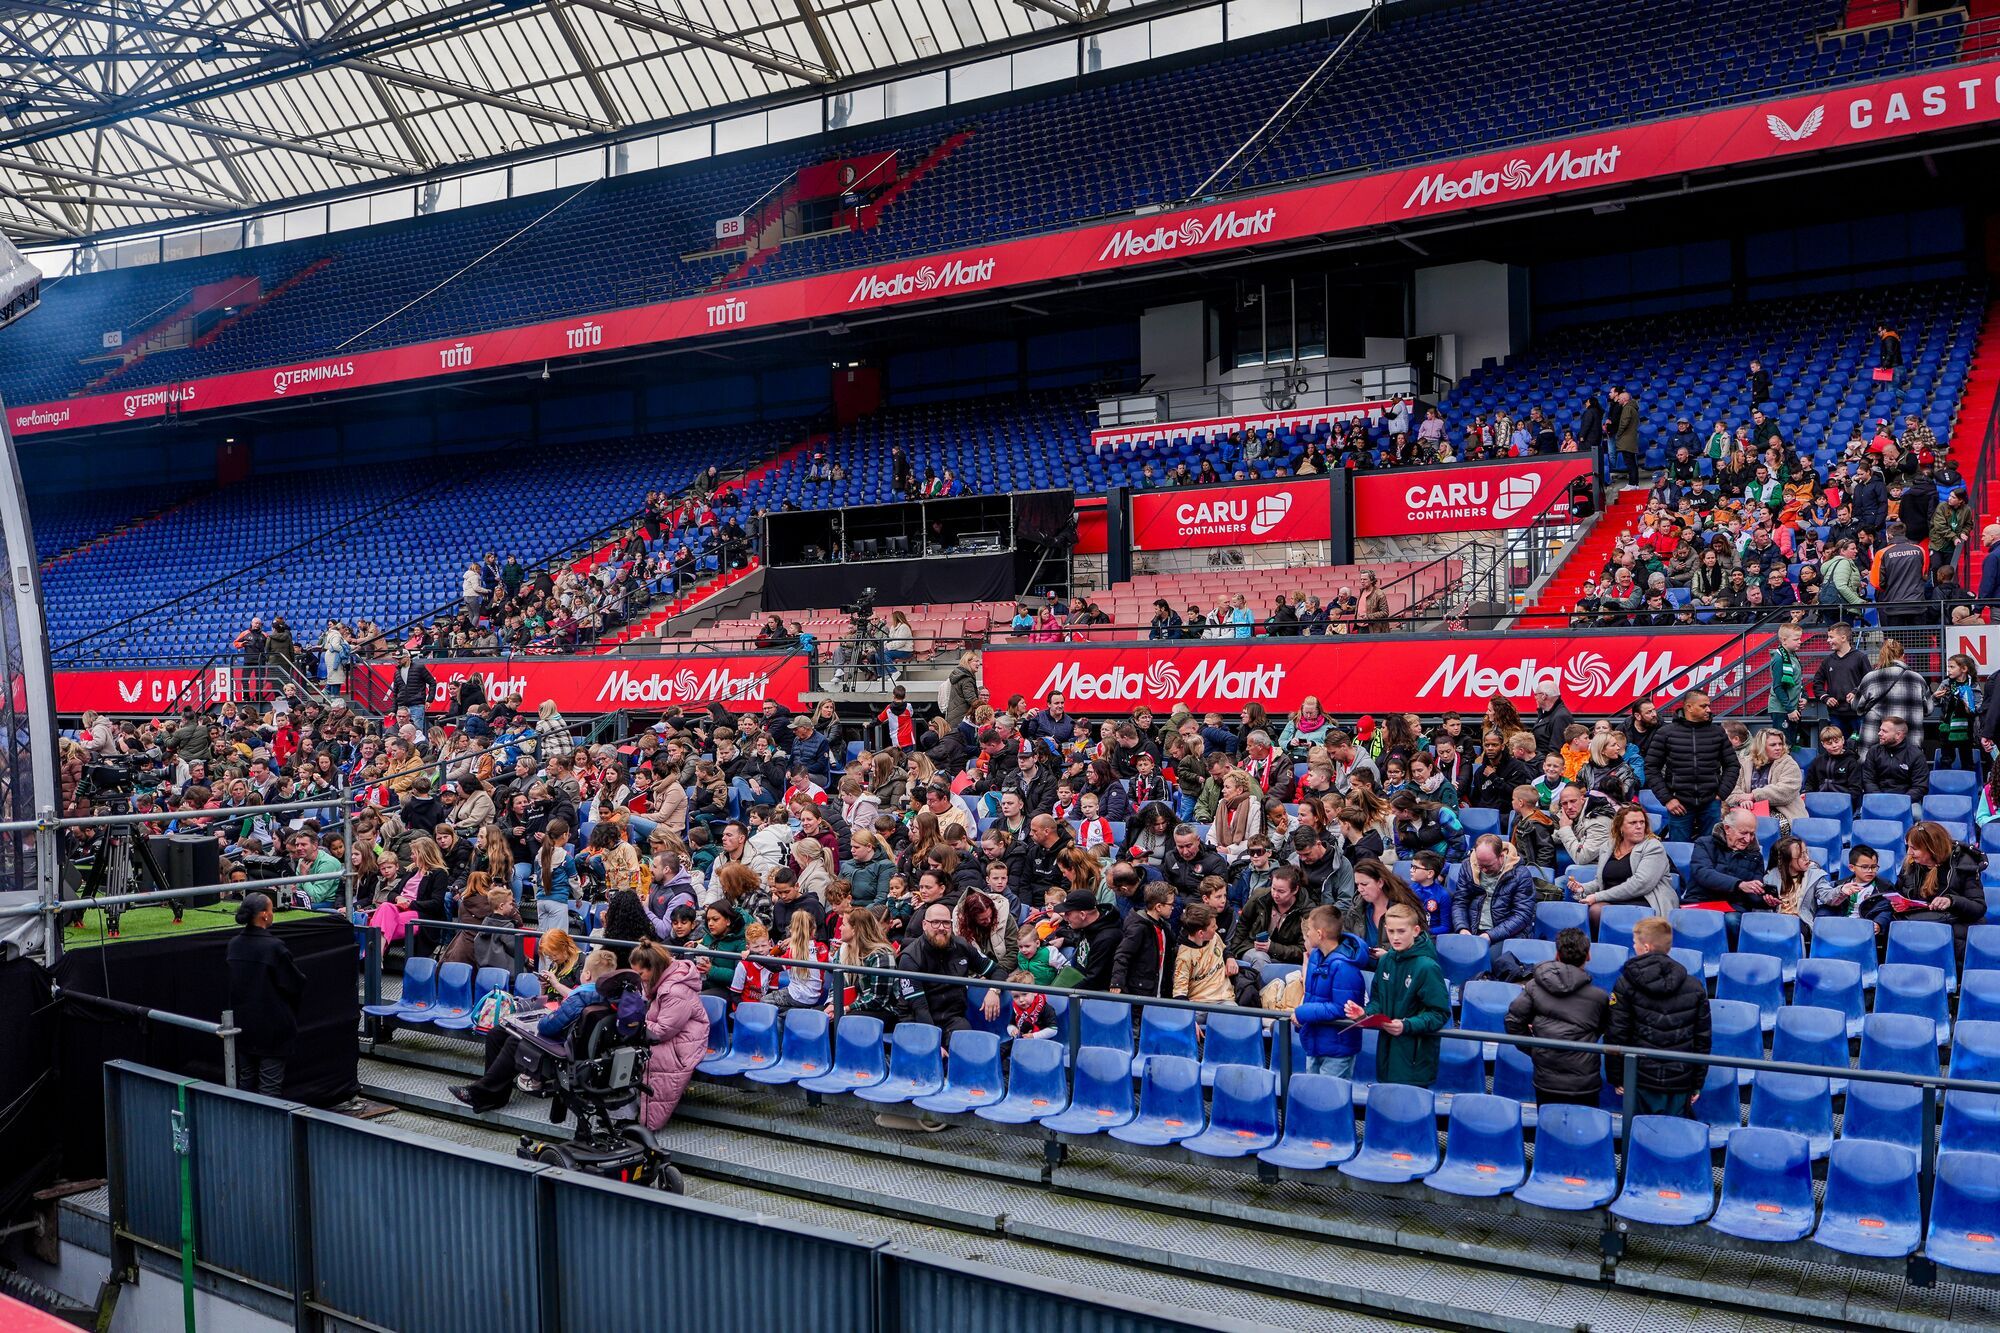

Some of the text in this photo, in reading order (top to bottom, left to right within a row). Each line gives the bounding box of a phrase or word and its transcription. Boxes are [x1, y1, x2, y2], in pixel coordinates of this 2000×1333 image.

[1850, 76, 2000, 129] CAST
[1402, 145, 1622, 209] Media Markt
[722, 221, 739, 234] BB
[1098, 208, 1276, 261] Media Markt
[848, 257, 996, 303] Media Markt
[707, 297, 747, 327] TOTO
[107, 334, 119, 344] CC
[566, 321, 602, 349] TOTO
[440, 343, 473, 369] TOTO
[273, 362, 355, 395] QTERMINALS
[1405, 481, 1489, 509] CARU
[1176, 500, 1248, 525] CARU
[1407, 507, 1487, 521] CONTAINERS
[1178, 523, 1247, 536] CONTAINERS
[1888, 549, 1921, 559] SECURITY
[1959, 635, 1988, 666] N
[219, 672, 227, 688] B
[595, 668, 770, 702] Media Markt
[1032, 659, 1286, 700] Media Markt
[1415, 654, 1562, 698] Media
